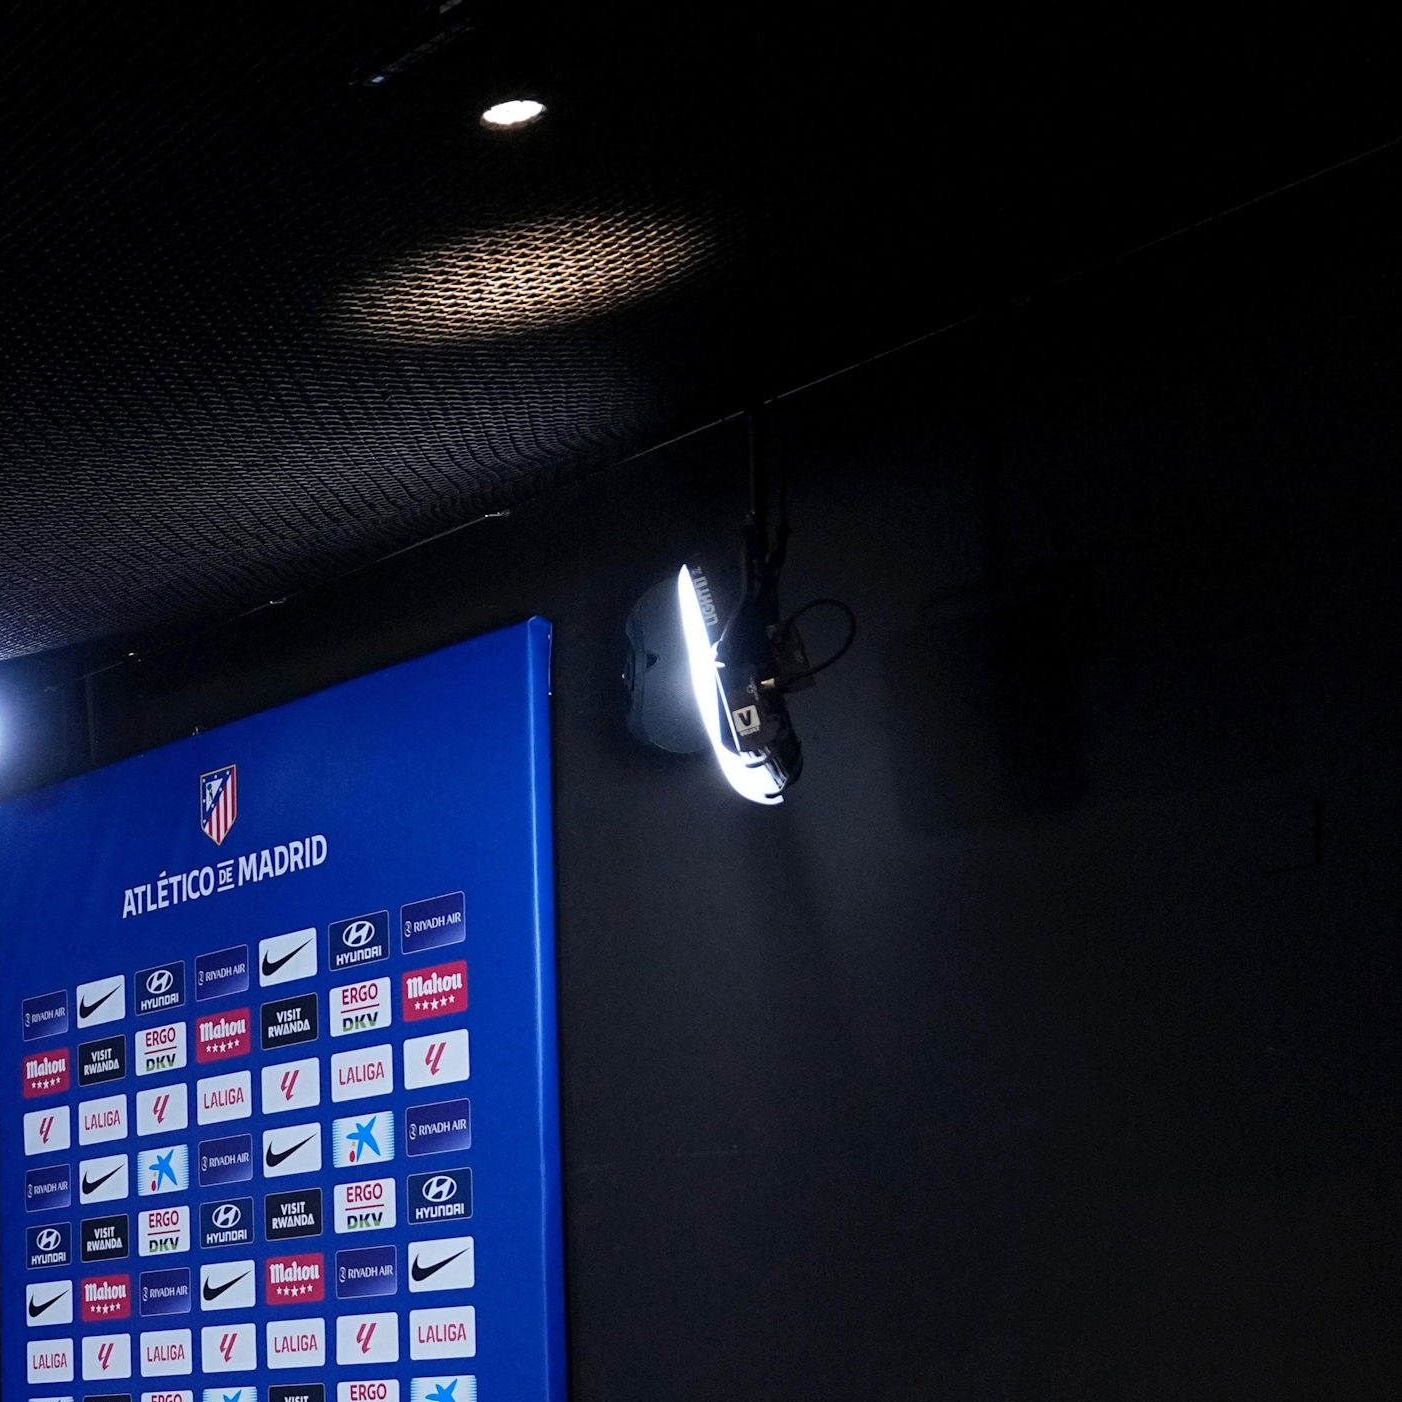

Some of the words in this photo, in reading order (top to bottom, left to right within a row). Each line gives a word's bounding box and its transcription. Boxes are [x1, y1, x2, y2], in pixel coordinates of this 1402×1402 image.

[122, 870, 215, 919] ATLÉTICO
[218, 866, 234, 885] DE
[238, 834, 327, 887] MADRID
[406, 972, 463, 999] Mahou
[141, 992, 179, 1011] HYUNDAI
[31, 1009, 54, 1023] RIYADH
[54, 1006, 66, 1017] AIR
[145, 1026, 176, 1048] ERGO
[91, 1047, 112, 1063] VISIT
[145, 1052, 176, 1072] DKV
[25, 1056, 66, 1080] Mahou
[84, 1058, 120, 1076] RWANDA
[339, 1061, 385, 1086] LALIGA
[84, 1109, 121, 1131] LALIGA
[33, 1182, 57, 1195] RIYADH
[57, 1180, 69, 1191] AIR
[148, 1210, 179, 1229] ERGO
[415, 1203, 465, 1219] HYUNDAI
[93, 1226, 115, 1239] VISIT
[86, 1237, 123, 1252] RWANDA
[149, 1236, 180, 1253] DKV
[31, 1252, 66, 1265] HYUNDAI
[269, 1260, 320, 1284] Mahou
[84, 1281, 127, 1302] Mahou
[149, 1286, 175, 1298] RIYADH
[175, 1285, 188, 1296] AIR
[418, 1322, 467, 1344] LALIGA
[32, 1352, 68, 1370] LALIGA
[146, 1343, 185, 1363] LALIGA
[350, 1383, 387, 1401] ERGO
